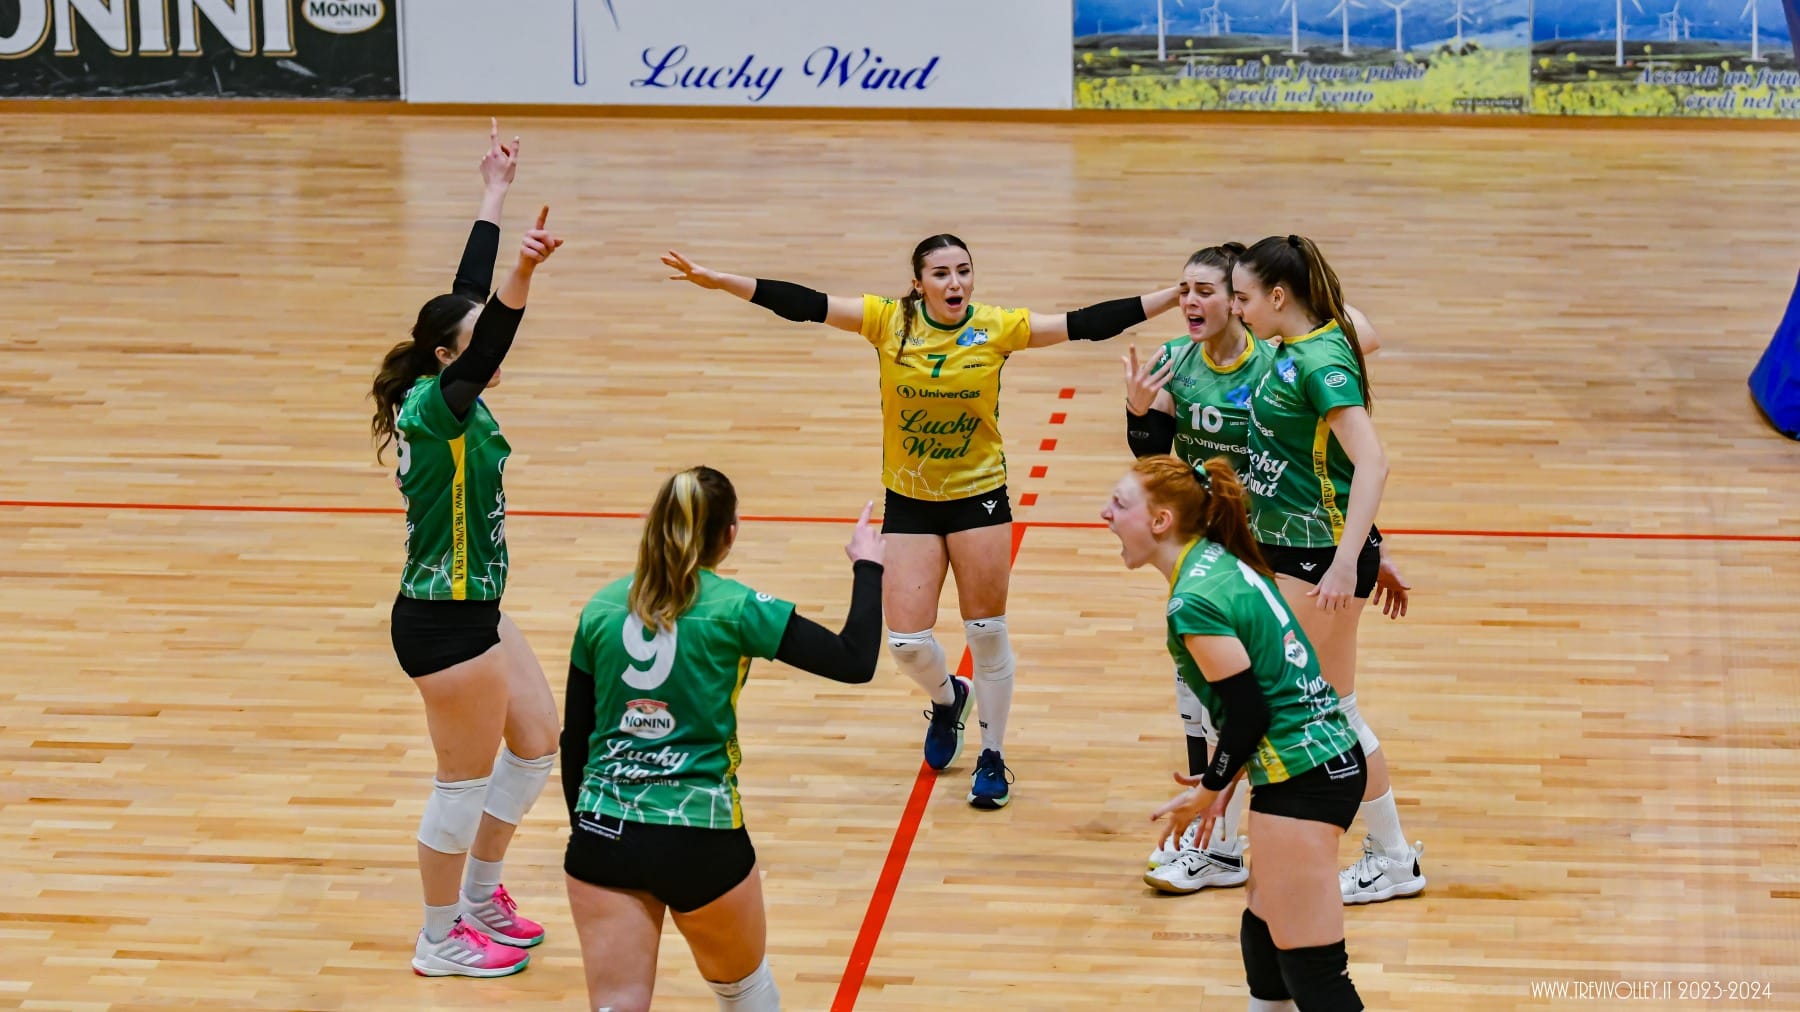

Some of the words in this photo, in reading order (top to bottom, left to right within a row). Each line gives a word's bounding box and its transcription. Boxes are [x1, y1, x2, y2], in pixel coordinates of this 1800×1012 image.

[310, 1, 377, 17] MONINI
[630, 45, 783, 101] Lucky
[803, 46, 940, 90] Wind
[1723, 71, 1751, 86] un
[1283, 85, 1316, 104] nel
[1742, 90, 1775, 108] nel
[927, 353, 947, 378] 7
[919, 388, 981, 399] UniverGas
[898, 409, 983, 439] Lucky
[1188, 402, 1223, 433] 10
[903, 436, 970, 459] Wind
[1194, 437, 1250, 455] UniverGa
[1189, 562, 1211, 577] DI
[621, 612, 678, 690] 9
[625, 715, 671, 729] MONINI
[600, 739, 689, 775] Lucky
